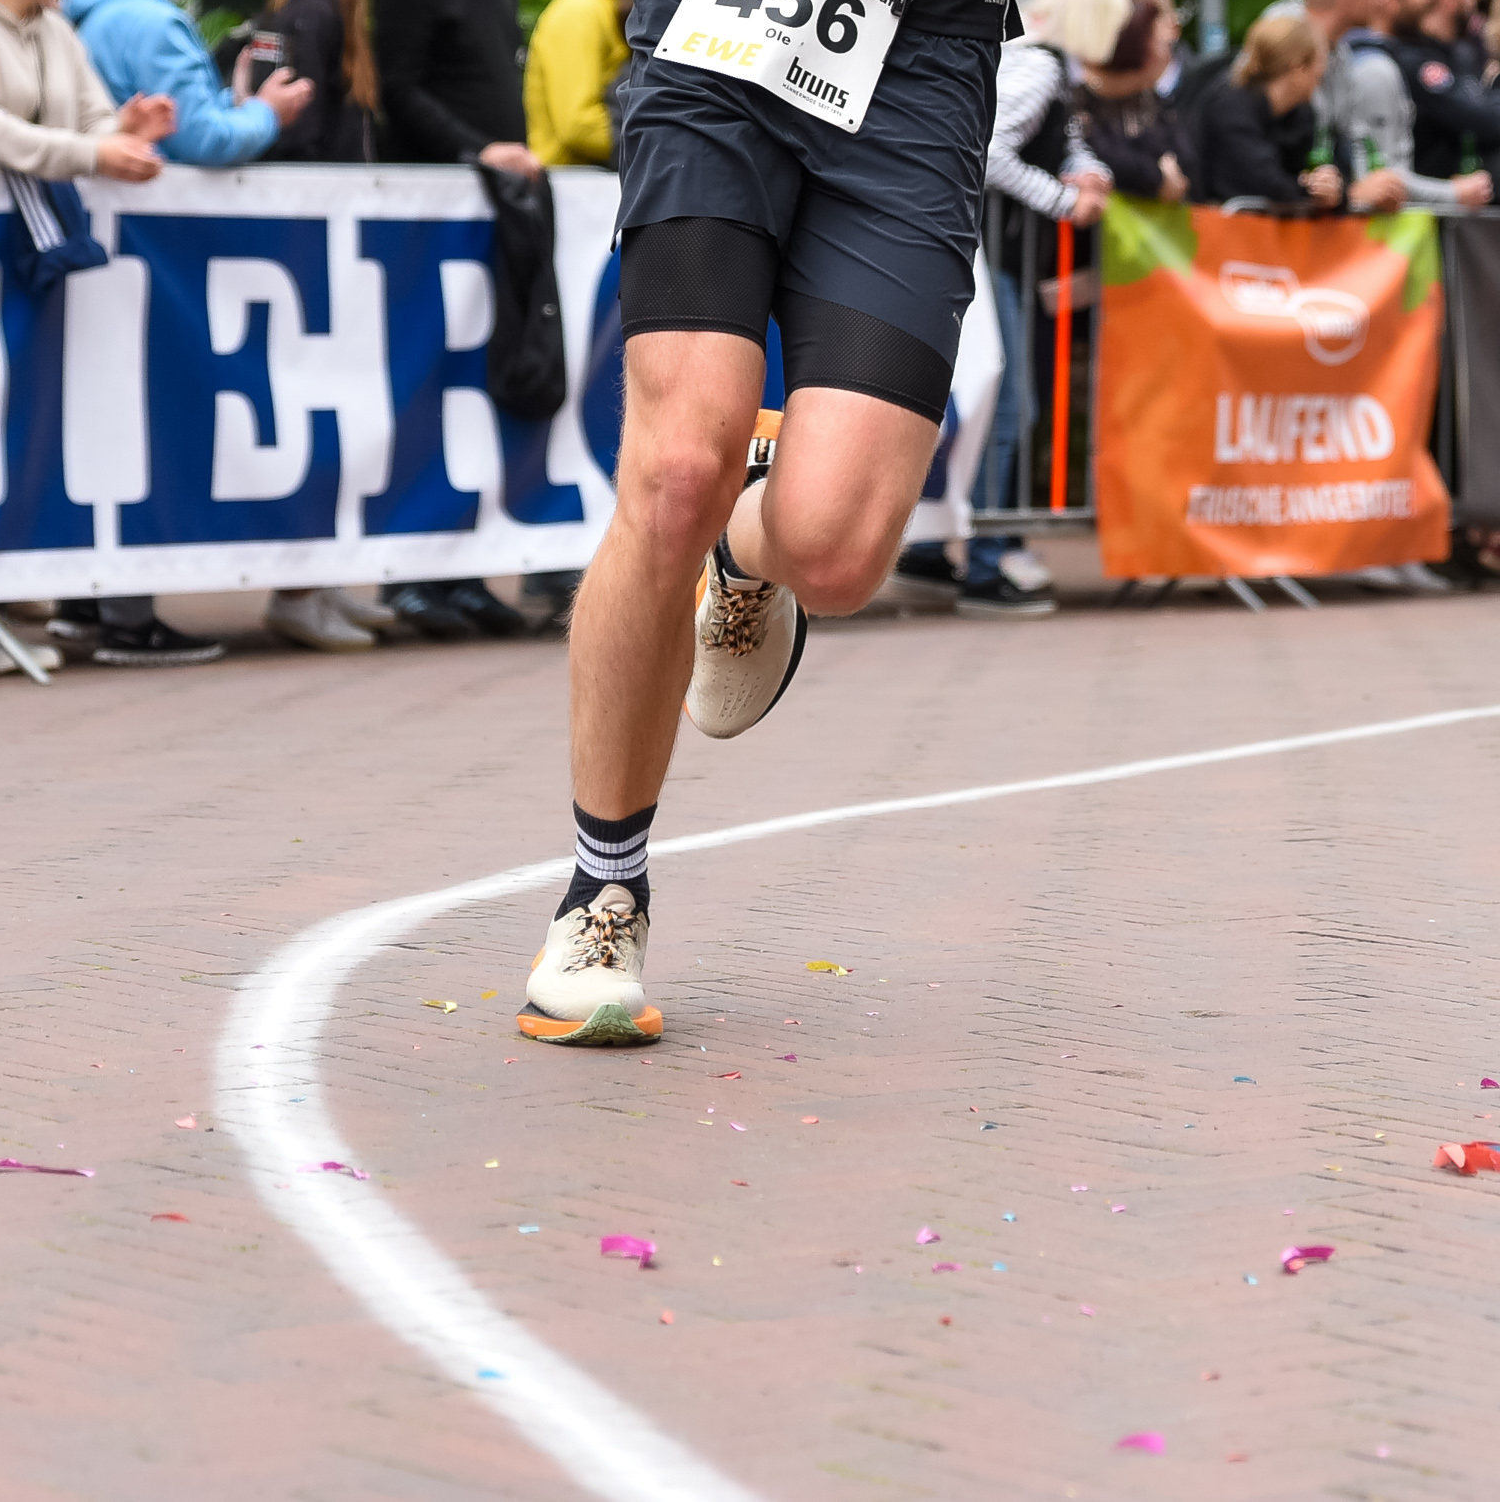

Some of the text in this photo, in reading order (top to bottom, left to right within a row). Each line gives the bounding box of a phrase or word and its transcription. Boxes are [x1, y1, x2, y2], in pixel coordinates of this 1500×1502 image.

[681, 31, 763, 67] EWE
[765, 28, 791, 45] Ole
[785, 55, 850, 109] bruns
[1213, 393, 1396, 464] LAUFEND
